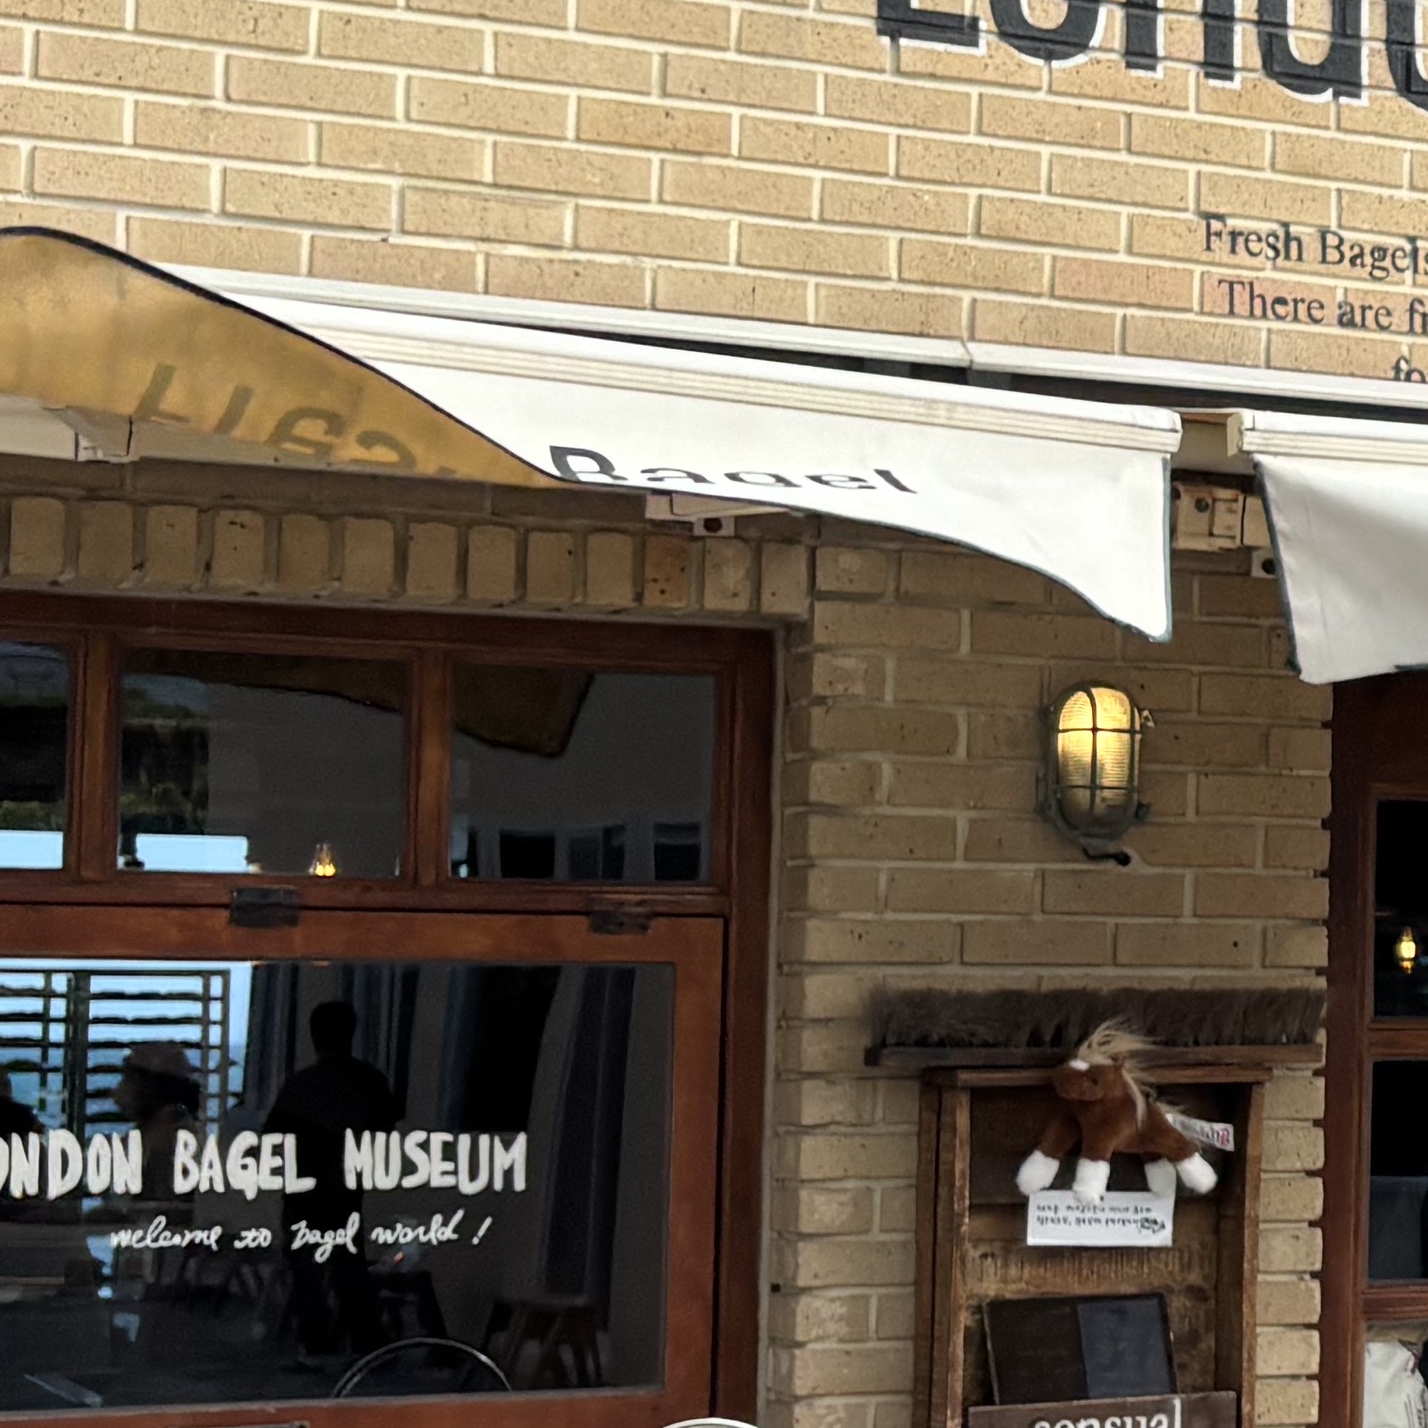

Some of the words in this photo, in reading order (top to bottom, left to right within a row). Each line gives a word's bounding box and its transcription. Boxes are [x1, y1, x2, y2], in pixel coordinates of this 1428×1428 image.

[1203, 213, 1302, 264] Fresh
[1218, 278, 1325, 325] There
[1336, 296, 1393, 332] are
[172, 1129, 316, 1200] BAGEL
[343, 1127, 527, 1196] MUSEUM
